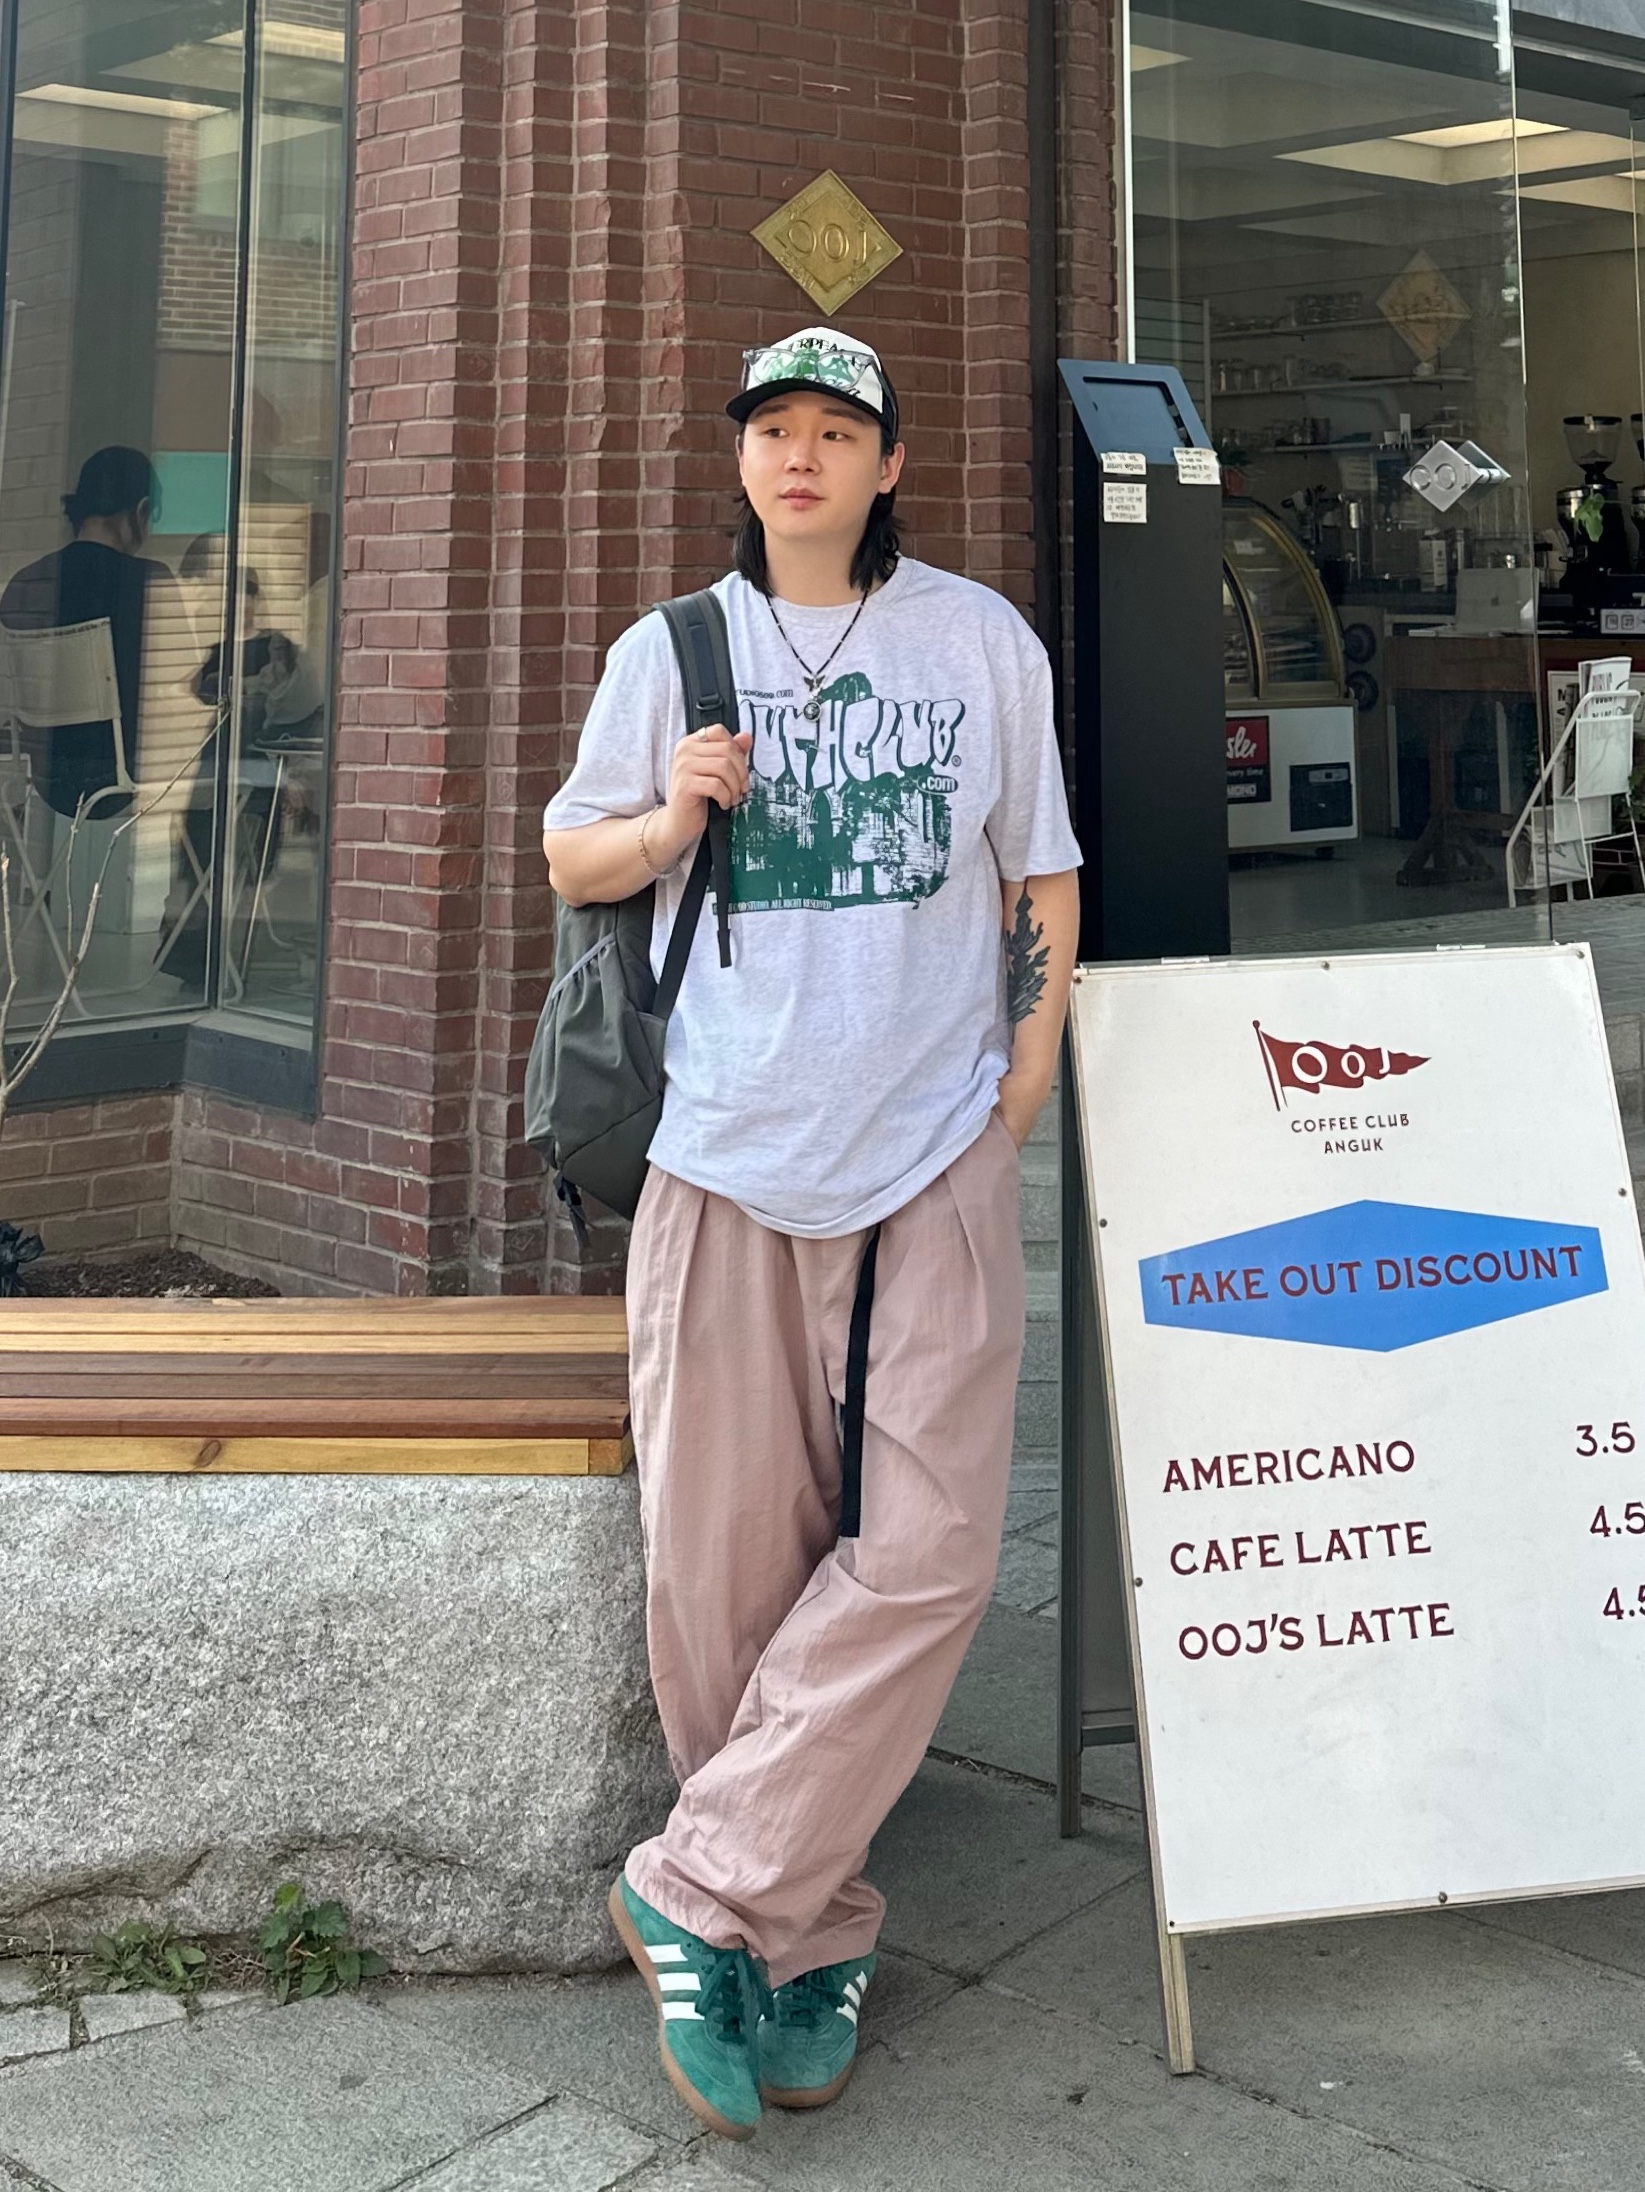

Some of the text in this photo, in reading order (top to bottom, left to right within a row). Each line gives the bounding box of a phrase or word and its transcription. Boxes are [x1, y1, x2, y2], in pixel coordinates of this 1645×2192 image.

[787, 218, 867, 268] OOJ
[1409, 462, 1471, 492] OOJ
[1291, 1046, 1392, 1085] OOJ
[1291, 1113, 1410, 1133] COFFEE CLUB
[1324, 1138, 1385, 1154] ANGUK
[1162, 1245, 1583, 1306] TAKE OUT DISCOUNT
[1162, 1421, 1637, 1493] AMERICANO 3.5
[1170, 1501, 1645, 1576] CAFE LATTE 4.5
[1178, 1613, 1304, 1660] OOJ'S
[1316, 1602, 1455, 1648] LATTE
